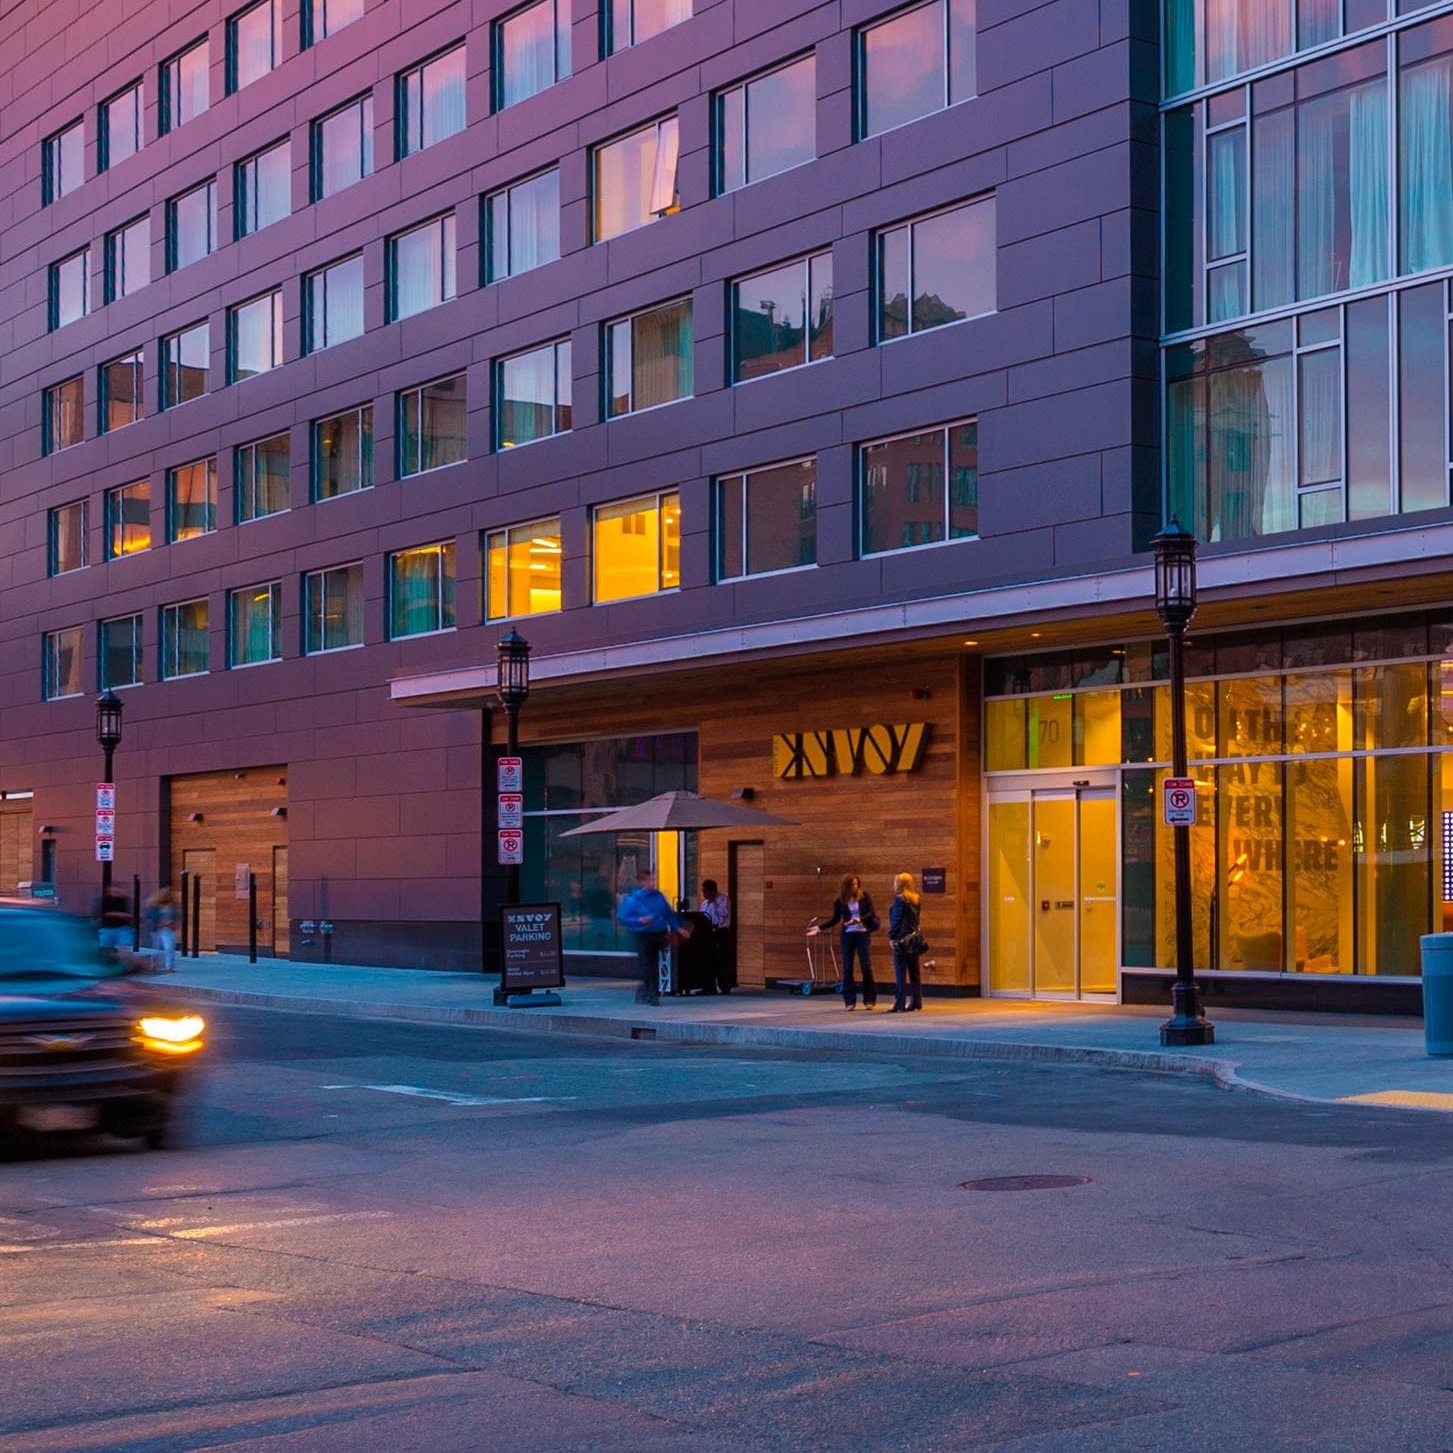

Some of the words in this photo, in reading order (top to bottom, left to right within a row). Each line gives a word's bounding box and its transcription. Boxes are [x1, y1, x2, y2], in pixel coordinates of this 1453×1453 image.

[1039, 720, 1059, 744] 70
[773, 723, 926, 778] ENVOY
[515, 923, 545, 932] VALET
[510, 932, 552, 943] PARKING
